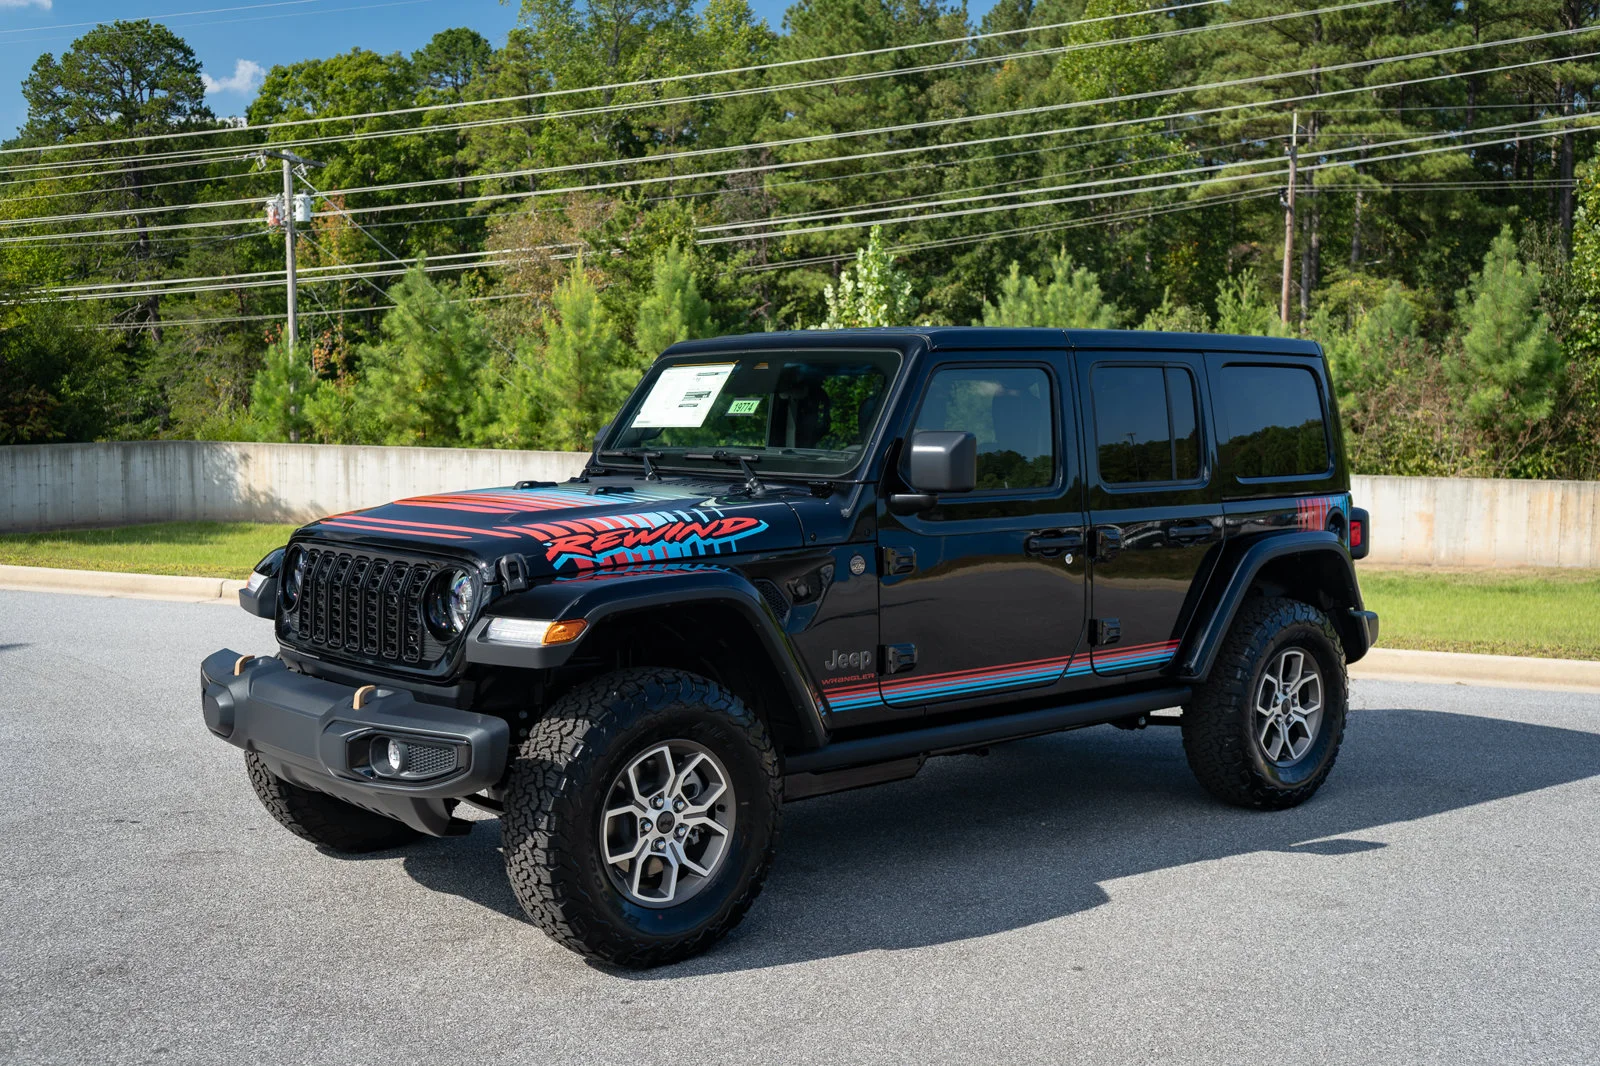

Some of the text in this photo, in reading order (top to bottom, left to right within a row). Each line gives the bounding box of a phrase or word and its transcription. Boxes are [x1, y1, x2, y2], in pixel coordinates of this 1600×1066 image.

[733, 402, 755, 412] 19774
[545, 516, 760, 562] REWIND
[824, 649, 872, 671] Jeep
[821, 673, 875, 685] WRANGLER
